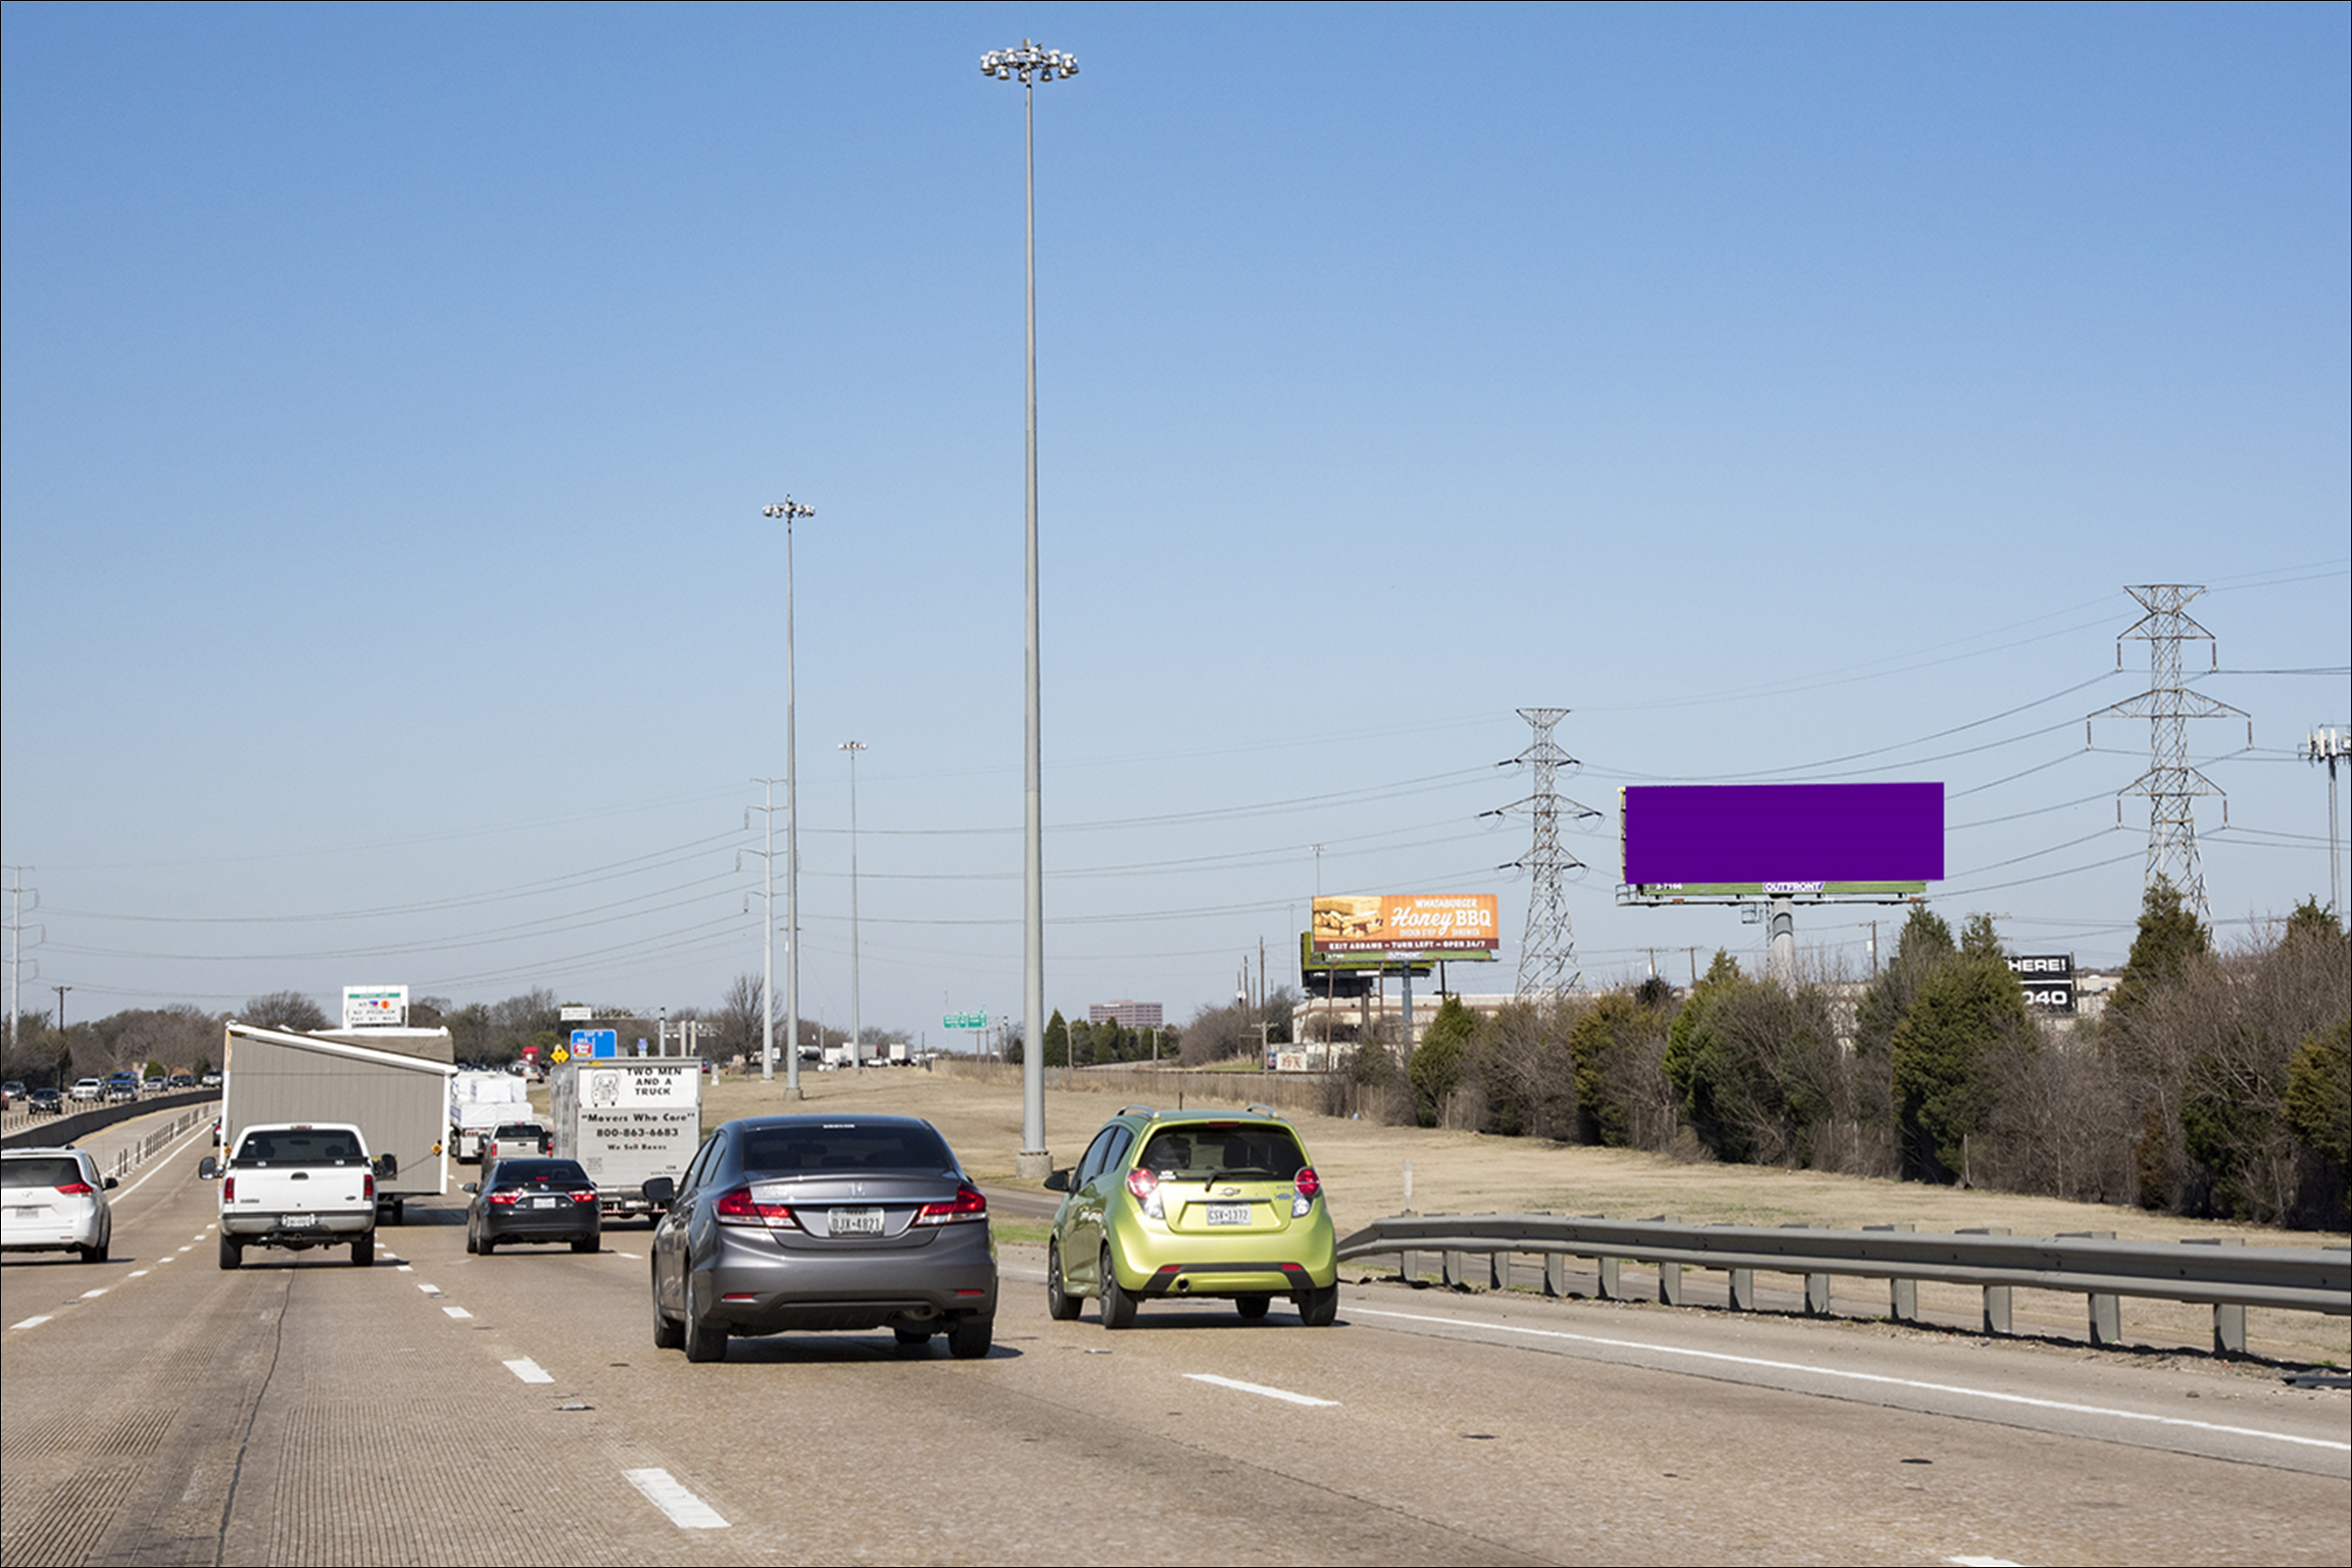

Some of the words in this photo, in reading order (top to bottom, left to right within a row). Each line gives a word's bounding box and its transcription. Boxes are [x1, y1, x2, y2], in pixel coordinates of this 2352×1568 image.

[1765, 882, 1823, 892] OUTFRONT
[1415, 899, 1478, 908] WHATABURGER
[1391, 906, 1454, 936] Honey
[1455, 909, 1492, 927] BBQ
[627, 1066, 653, 1076] TWO
[658, 1066, 682, 1075] MEN
[633, 1113, 658, 1122] Who
[596, 1128, 678, 1138] 800-863-6683
